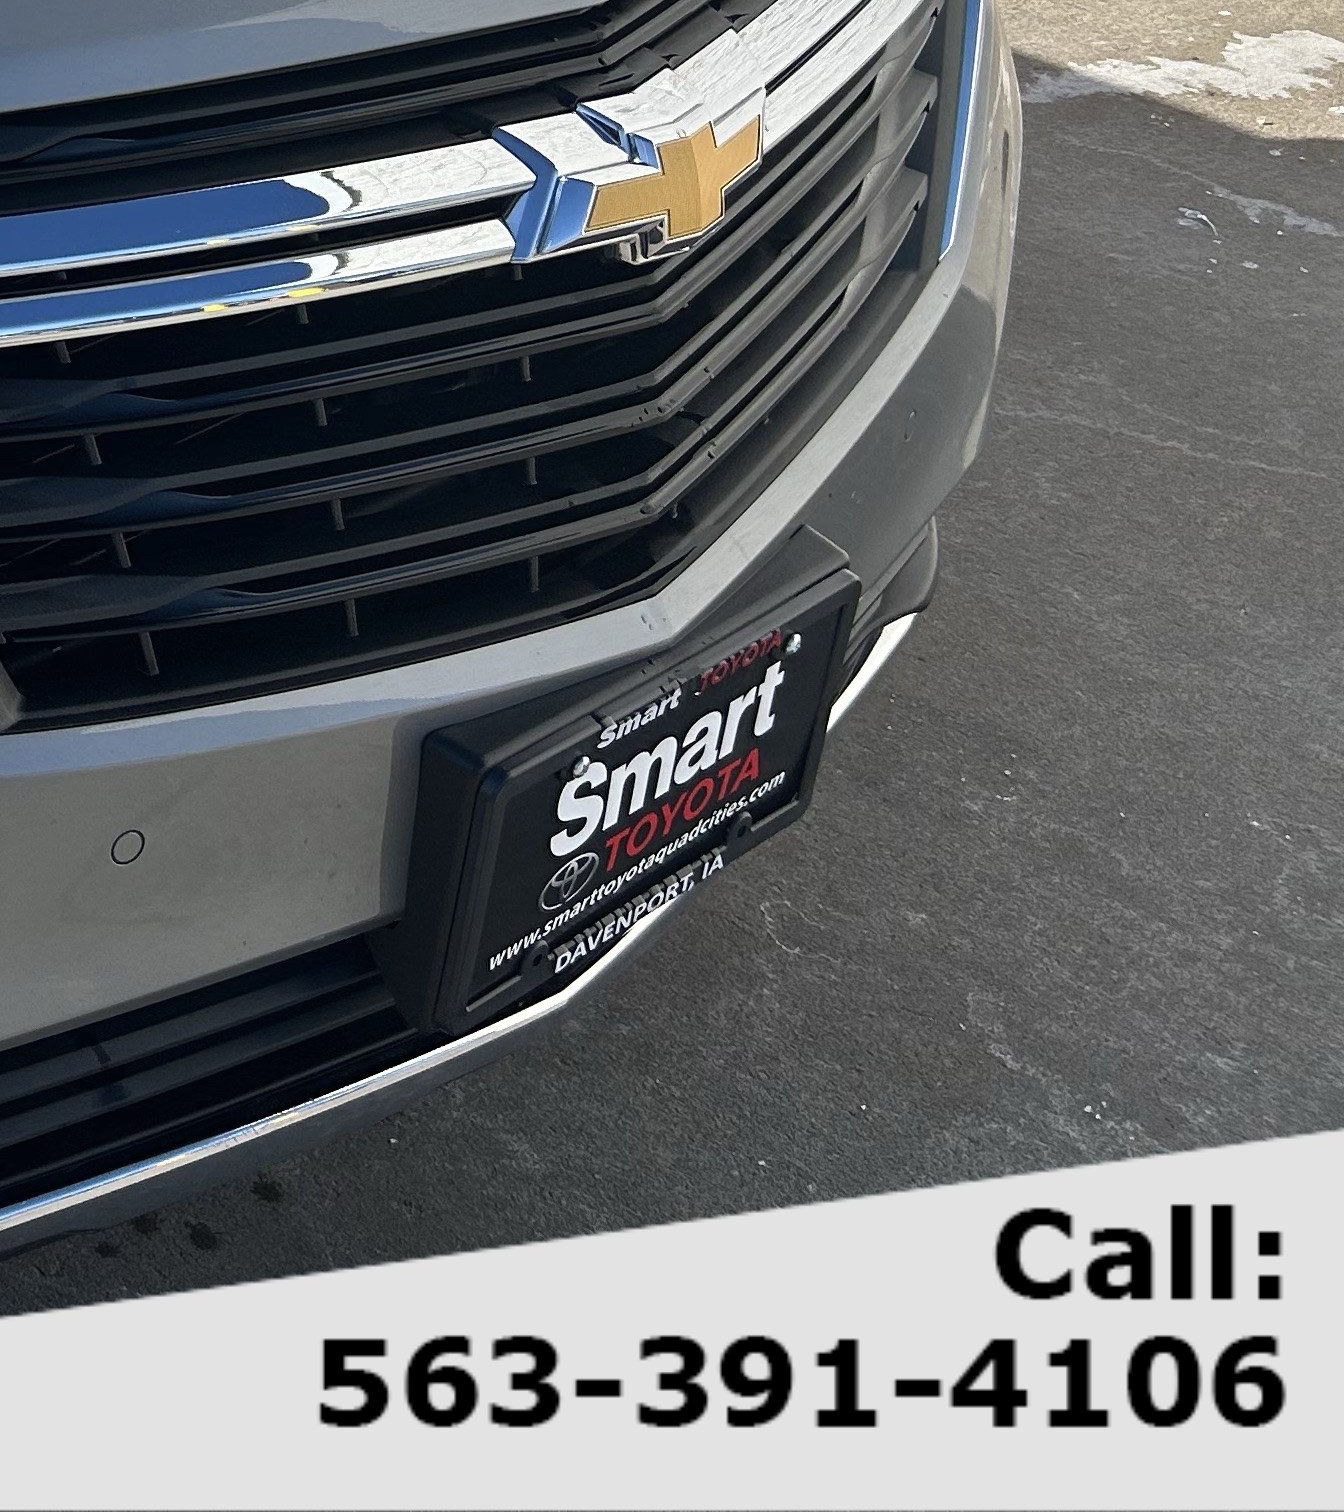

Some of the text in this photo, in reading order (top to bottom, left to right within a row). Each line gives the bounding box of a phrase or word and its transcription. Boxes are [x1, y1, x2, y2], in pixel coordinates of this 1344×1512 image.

[596, 627, 782, 749] Smart TOYOTA
[550, 660, 786, 857] Smart
[605, 748, 761, 873] TOYOTA
[488, 771, 786, 971] www.smarttoyotaquadcities.com
[554, 854, 725, 974] DAVENPORT, IA
